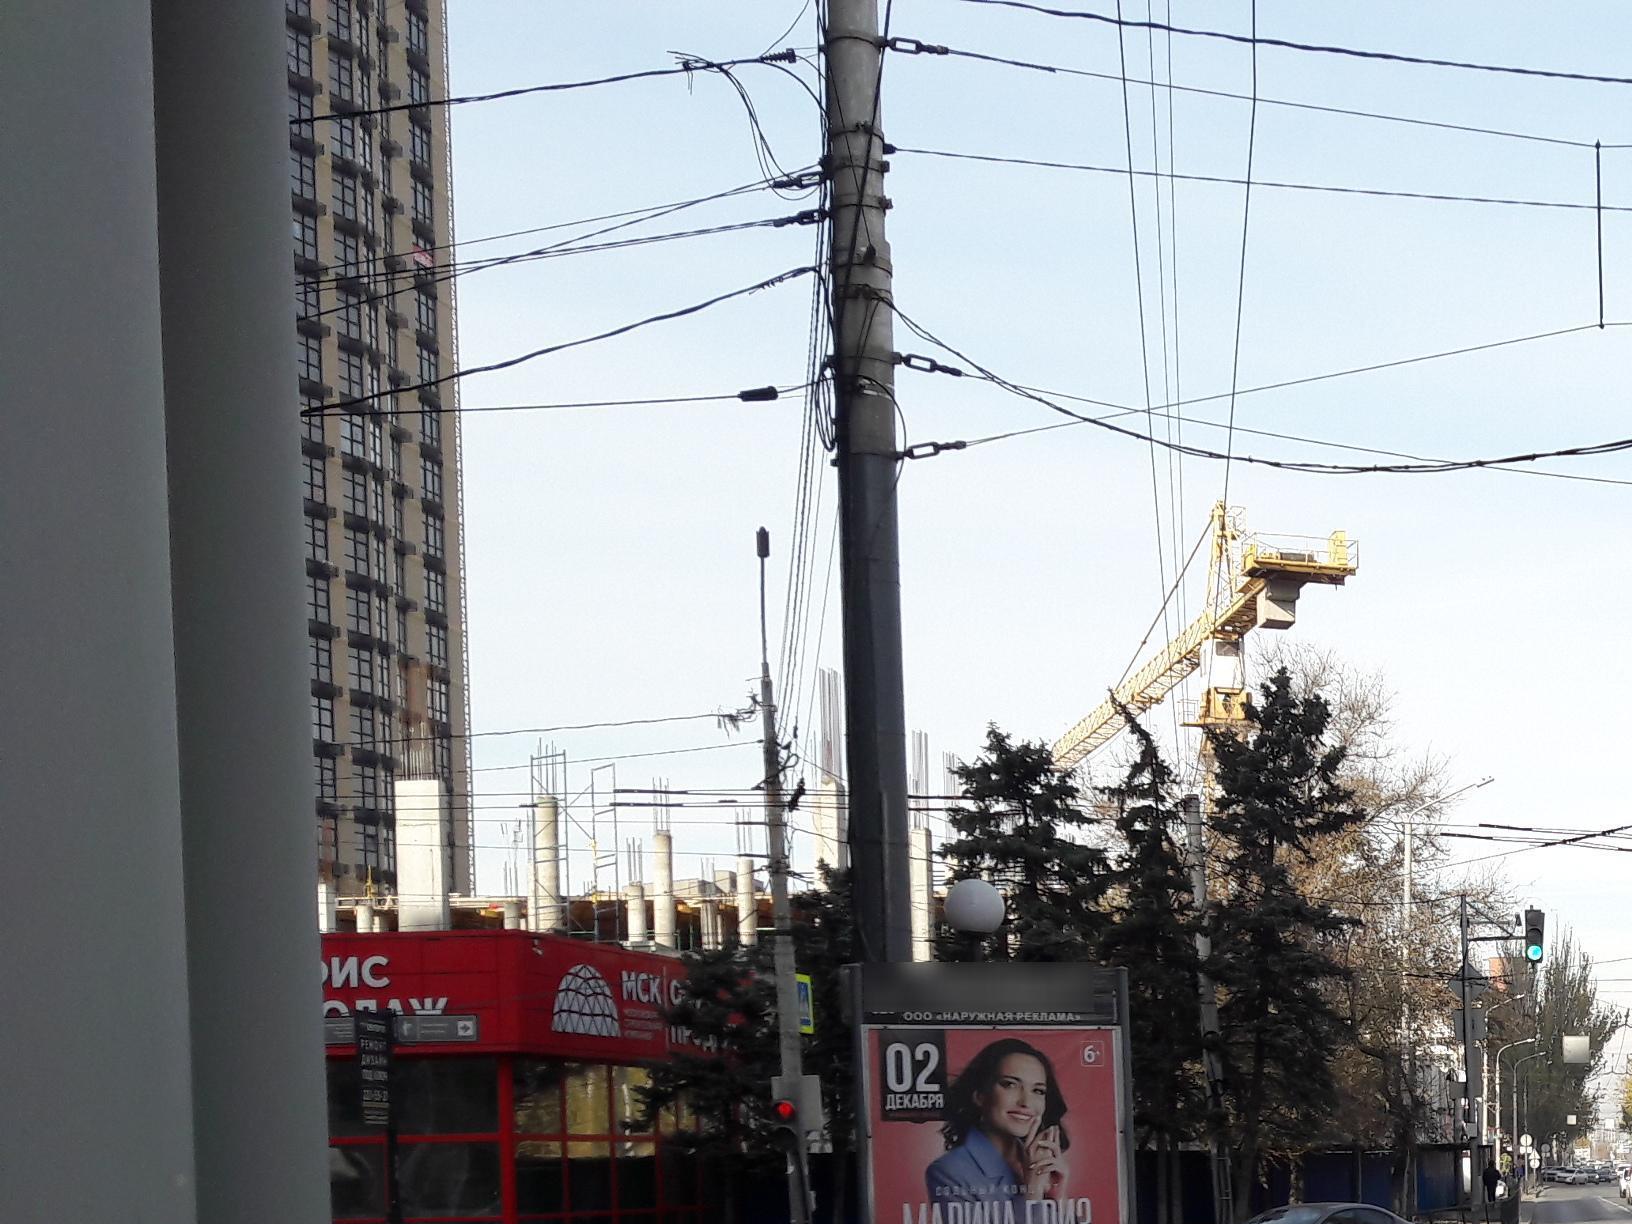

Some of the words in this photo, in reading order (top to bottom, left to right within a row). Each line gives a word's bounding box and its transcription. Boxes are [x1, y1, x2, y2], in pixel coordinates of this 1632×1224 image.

[621, 970, 662, 1005] МСК
[903, 1011, 933, 1022] ООО
[935, 1011, 1015, 1022] «НАРУЖНАЯ
[1016, 1011, 1081, 1022] РЕКЛАМА»
[886, 1042, 940, 1093] 02
[885, 1093, 945, 1111] ДЕКАБРЯ
